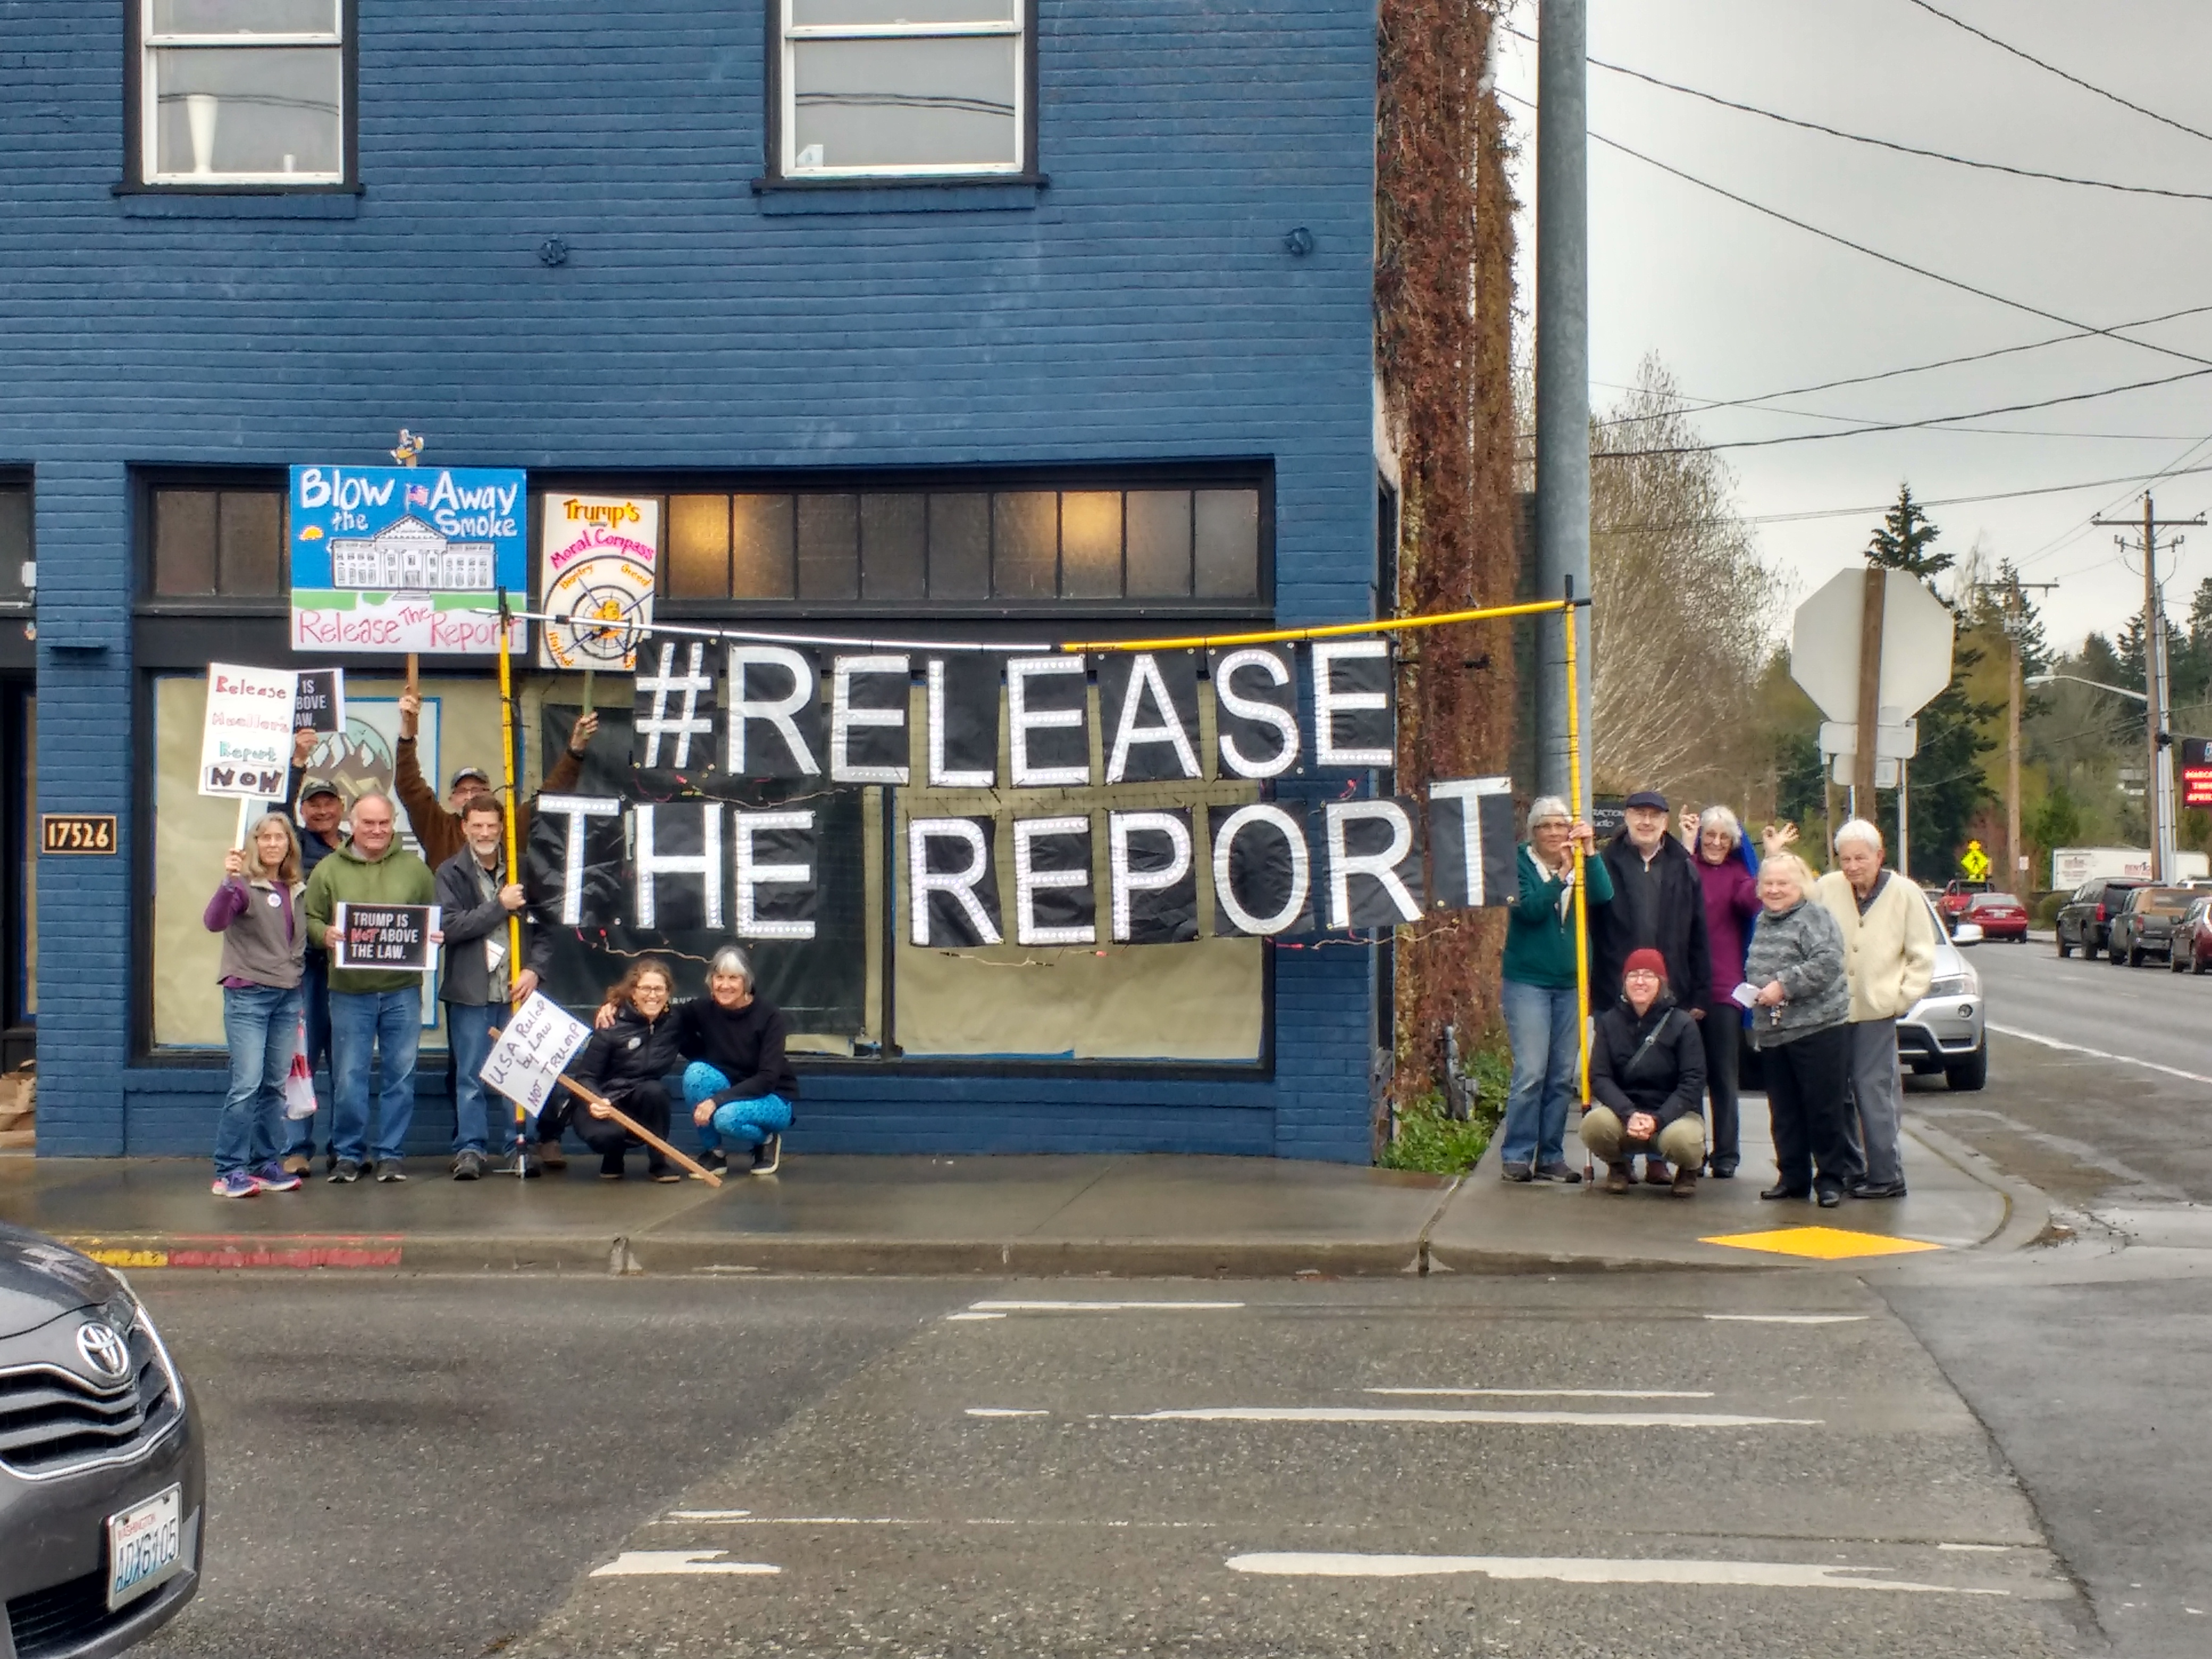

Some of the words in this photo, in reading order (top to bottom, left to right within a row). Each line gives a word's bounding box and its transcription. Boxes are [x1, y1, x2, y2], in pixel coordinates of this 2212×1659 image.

[300, 468, 396, 510] Blow
[429, 470, 518, 516] Away
[332, 511, 369, 532] the
[434, 509, 517, 538] Smoke
[563, 499, 641, 528] Trump's
[550, 530, 592, 569] Moral
[594, 528, 655, 563] Compass
[299, 609, 401, 644] Release
[398, 607, 431, 626] The
[430, 611, 522, 651] Report
[216, 675, 287, 699] Release
[301, 679, 315, 693] IS
[296, 694, 327, 710] BOVE
[635, 640, 1393, 787] #RELEASE
[295, 713, 316, 726] AW.
[211, 767, 283, 793] NOW
[48, 822, 109, 847] 17526
[537, 794, 816, 939] THE
[910, 777, 1511, 945] REPORT
[352, 911, 394, 927] TRUMP
[396, 913, 409, 927] IS
[350, 928, 379, 943] NOT
[379, 928, 419, 943] ABOVE
[351, 943, 374, 958] THE
[376, 944, 407, 960] LAW.
[489, 1041, 520, 1085] USA
[516, 1052, 539, 1069] by
[527, 1079, 542, 1107] NOT
[115, 1517, 177, 1592] ADX6105
